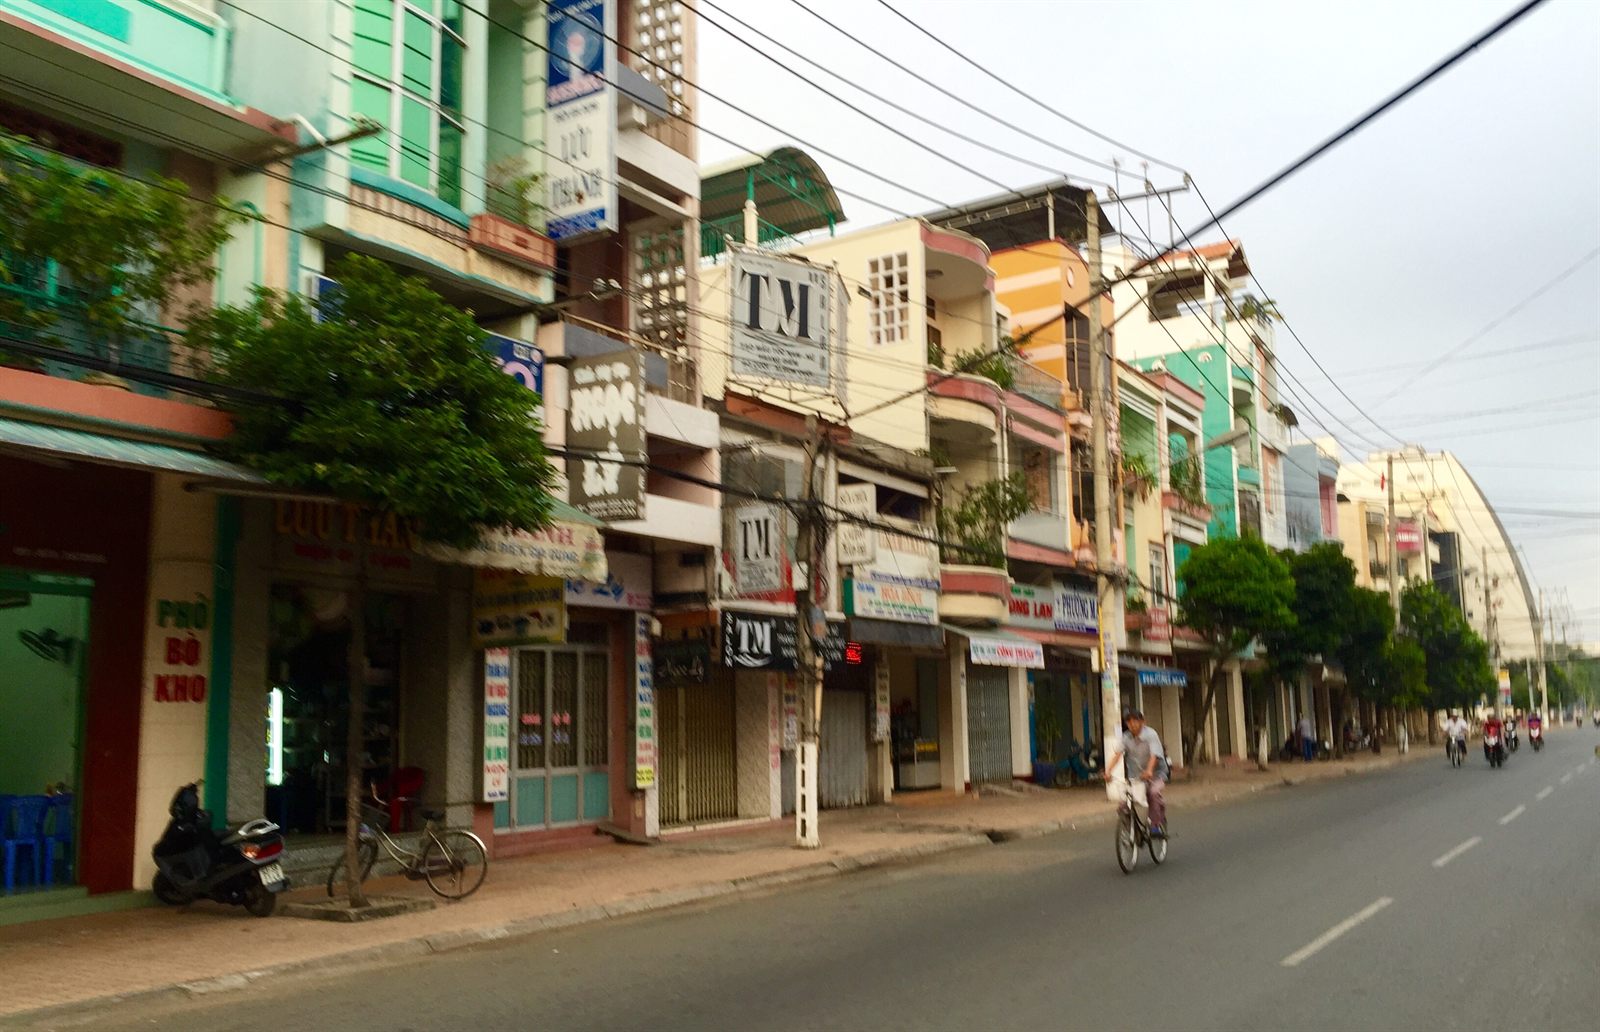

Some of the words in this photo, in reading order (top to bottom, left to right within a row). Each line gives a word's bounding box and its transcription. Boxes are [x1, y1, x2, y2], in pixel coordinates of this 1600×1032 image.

[740, 264, 814, 340] TM
[738, 518, 772, 562] TM
[1033, 600, 1053, 619] LAN
[164, 630, 201, 667] BÒ
[724, 611, 734, 668] SALON
[736, 617, 772, 656] TM
[154, 674, 206, 703] KHO
